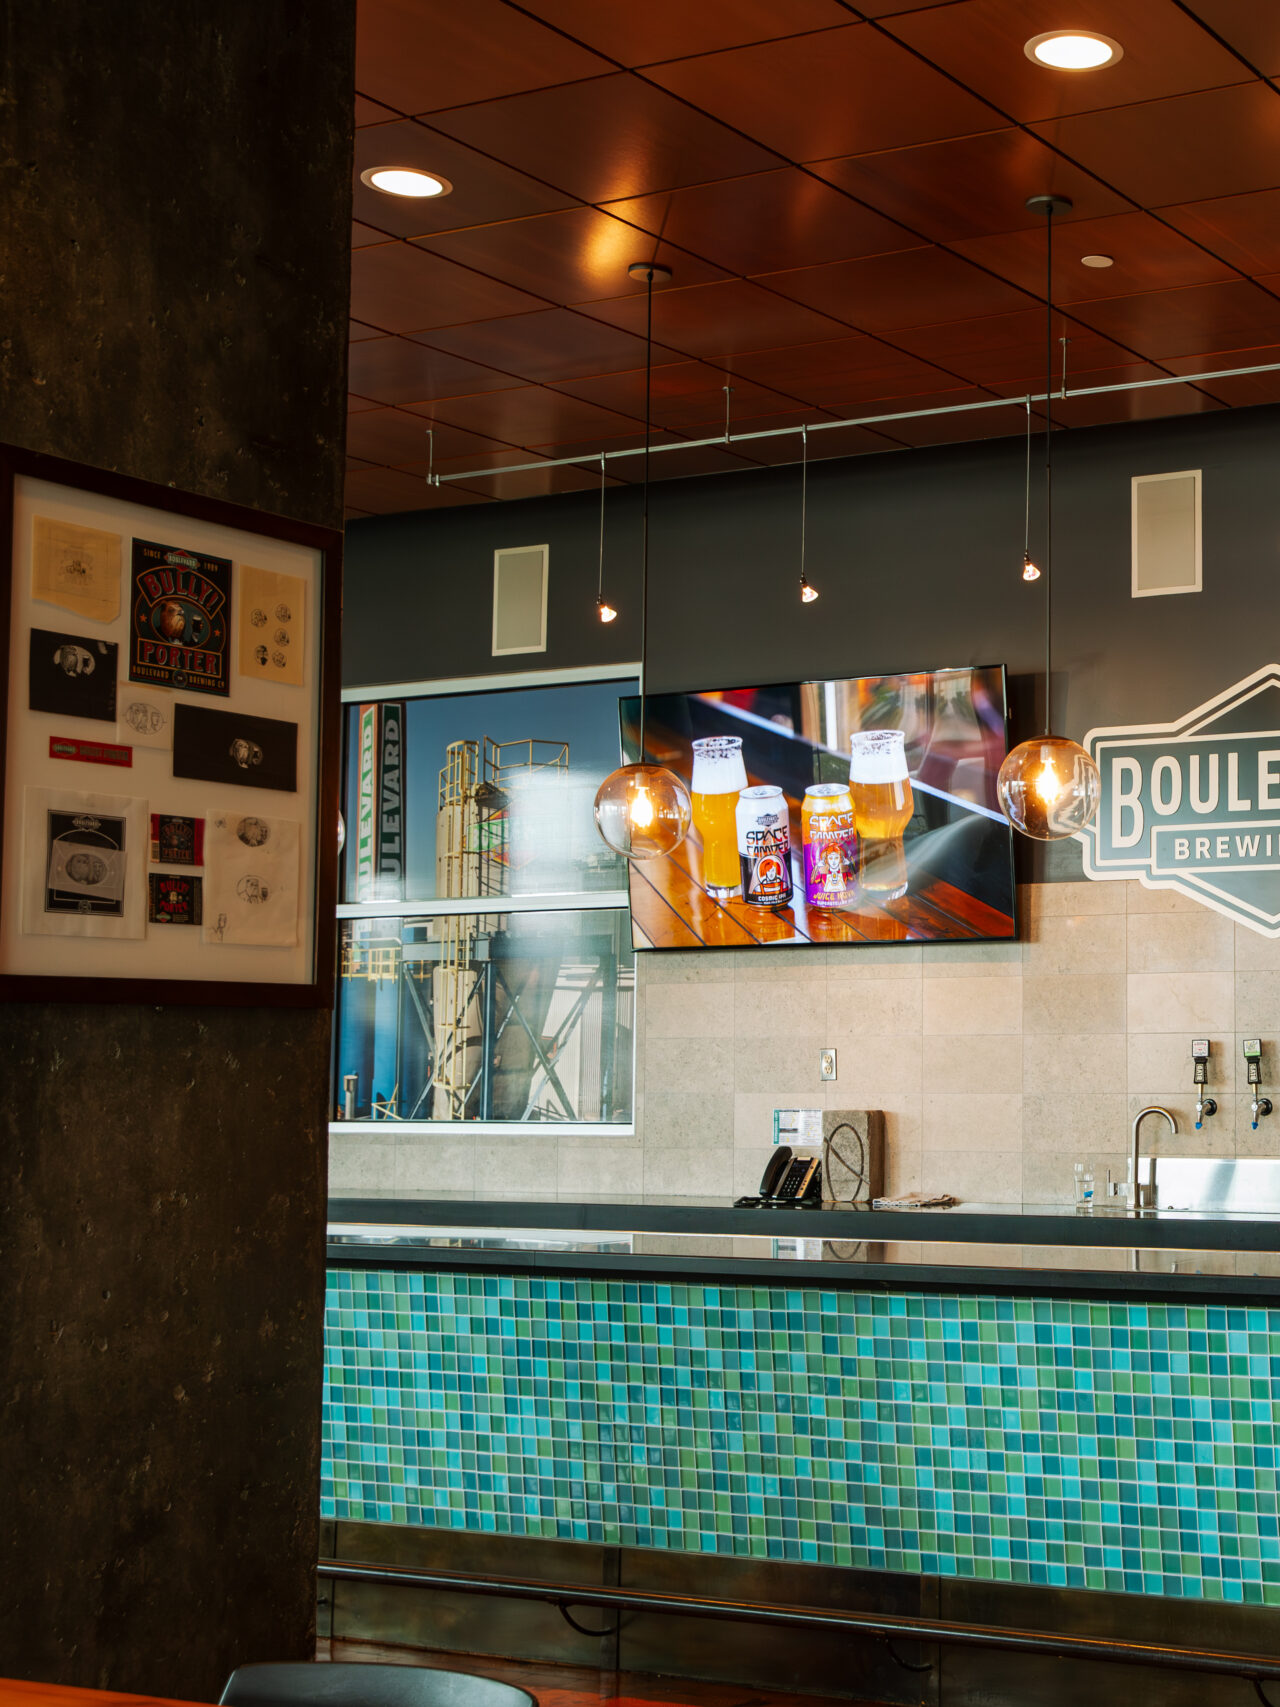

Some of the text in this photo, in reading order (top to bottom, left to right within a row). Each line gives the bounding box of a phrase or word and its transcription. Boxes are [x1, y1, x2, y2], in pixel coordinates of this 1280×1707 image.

[144, 569, 219, 612] BULLY!
[143, 642, 218, 674] PORTER
[810, 812, 853, 828] SPACE
[746, 826, 788, 845] SPACE
